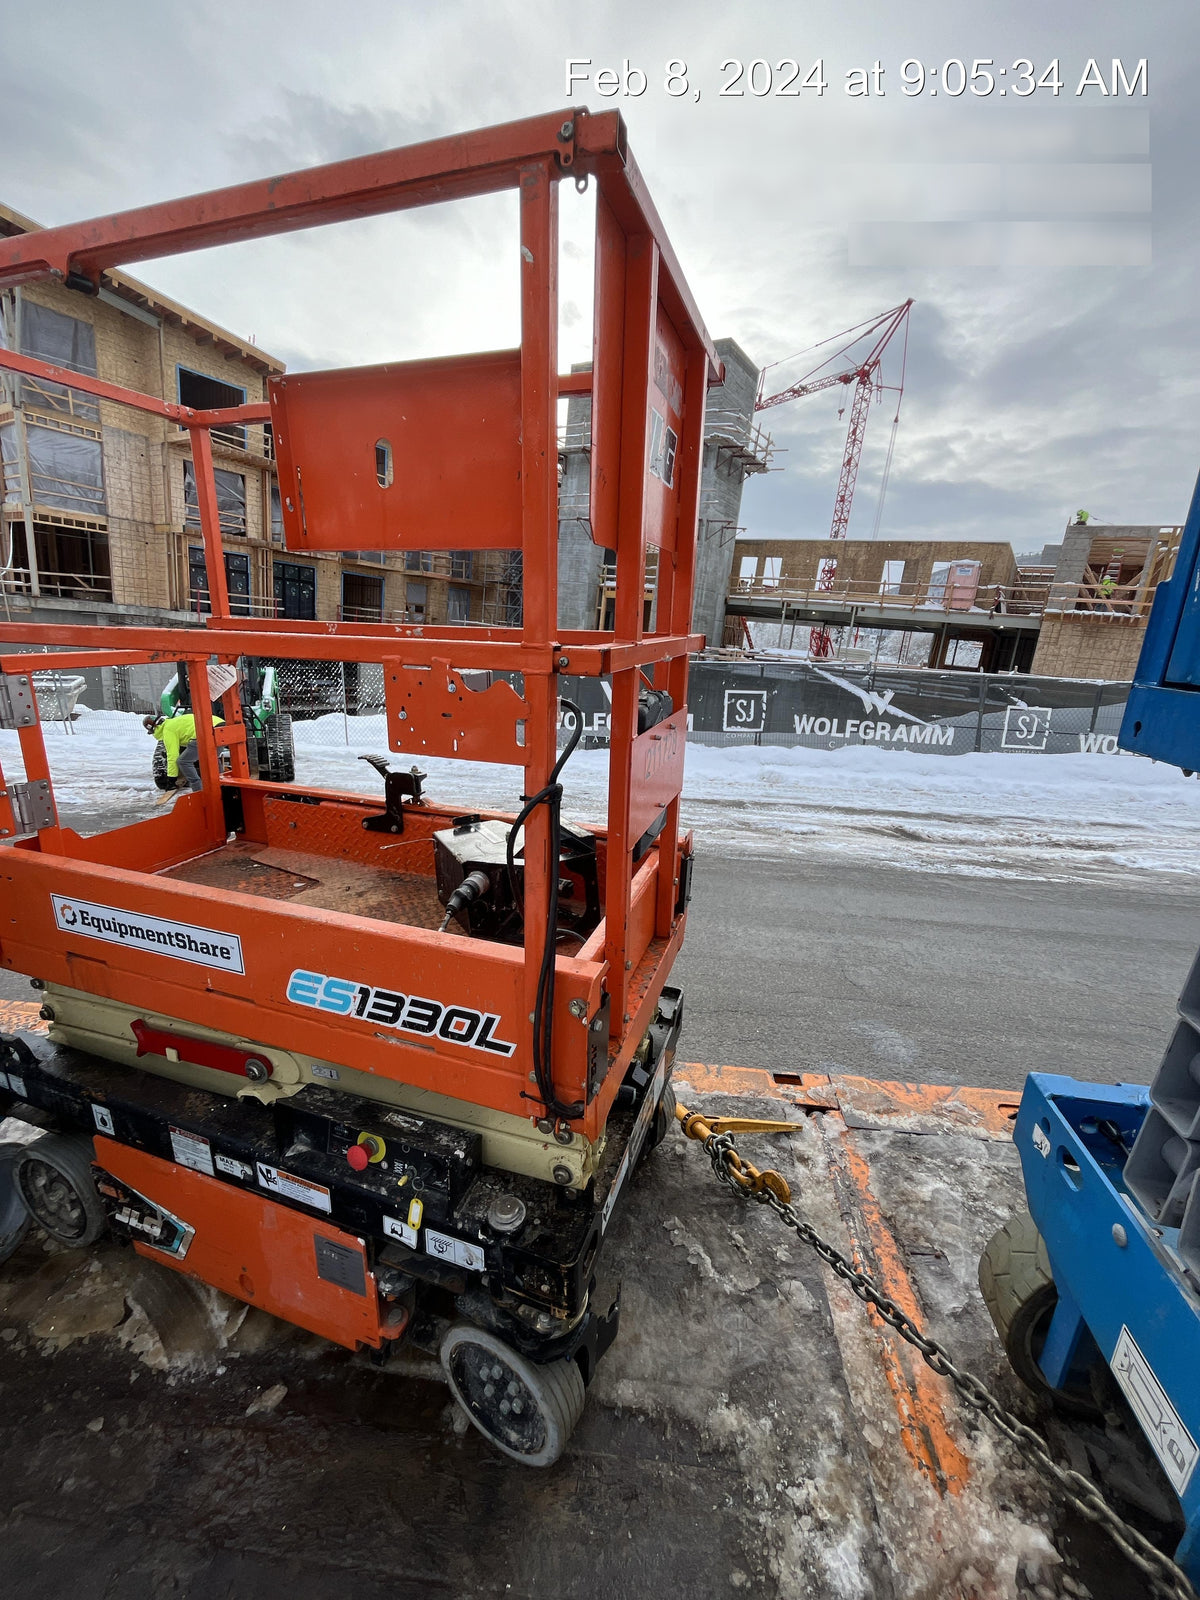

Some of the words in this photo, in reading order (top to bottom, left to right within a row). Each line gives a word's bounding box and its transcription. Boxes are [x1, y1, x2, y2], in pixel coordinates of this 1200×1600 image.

[735, 699, 755, 722] SJ
[793, 713, 956, 746] WOLFGRAMM
[78, 909, 232, 960] EquipmentShare
[287, 970, 516, 1056] ES1330L
